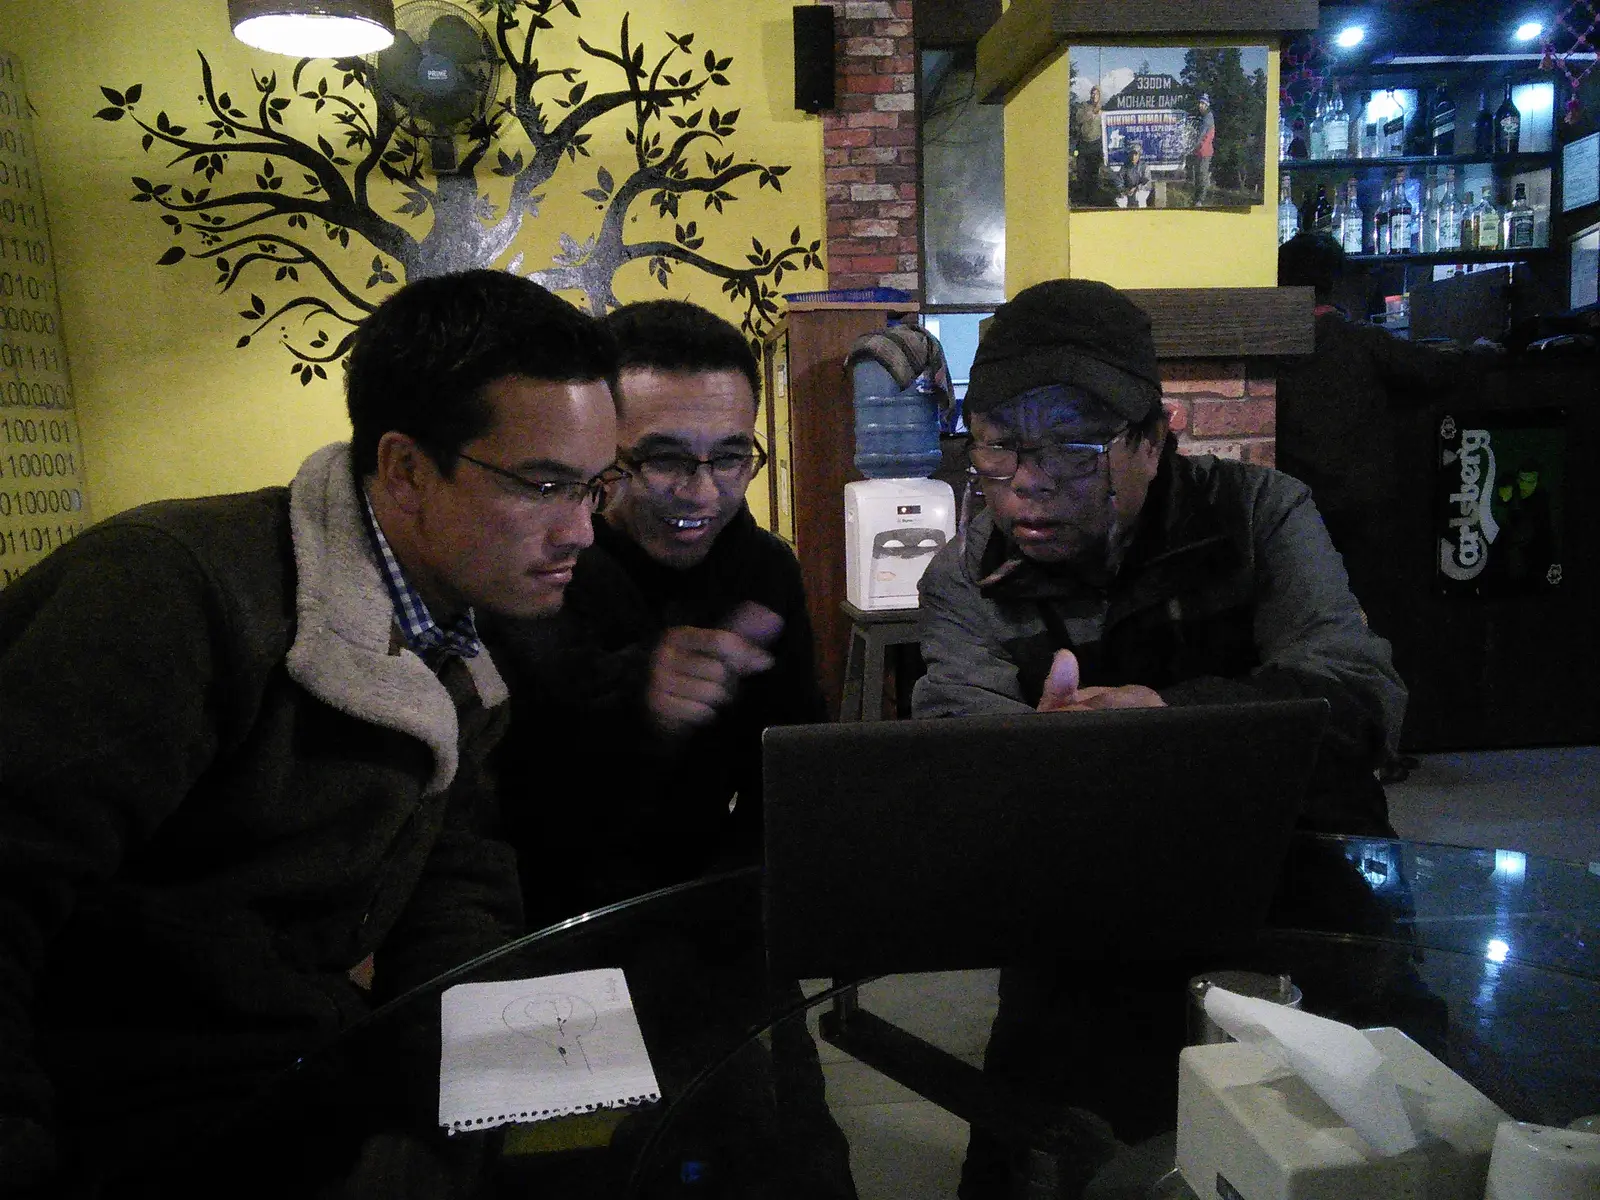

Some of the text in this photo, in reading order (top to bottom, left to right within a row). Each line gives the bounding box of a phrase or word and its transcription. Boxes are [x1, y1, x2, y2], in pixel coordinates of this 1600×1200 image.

[1117, 94, 1189, 108] MOHARE DAN
[2, 418, 71, 444] 100101
[1441, 429, 1500, 581] Carlsberg
